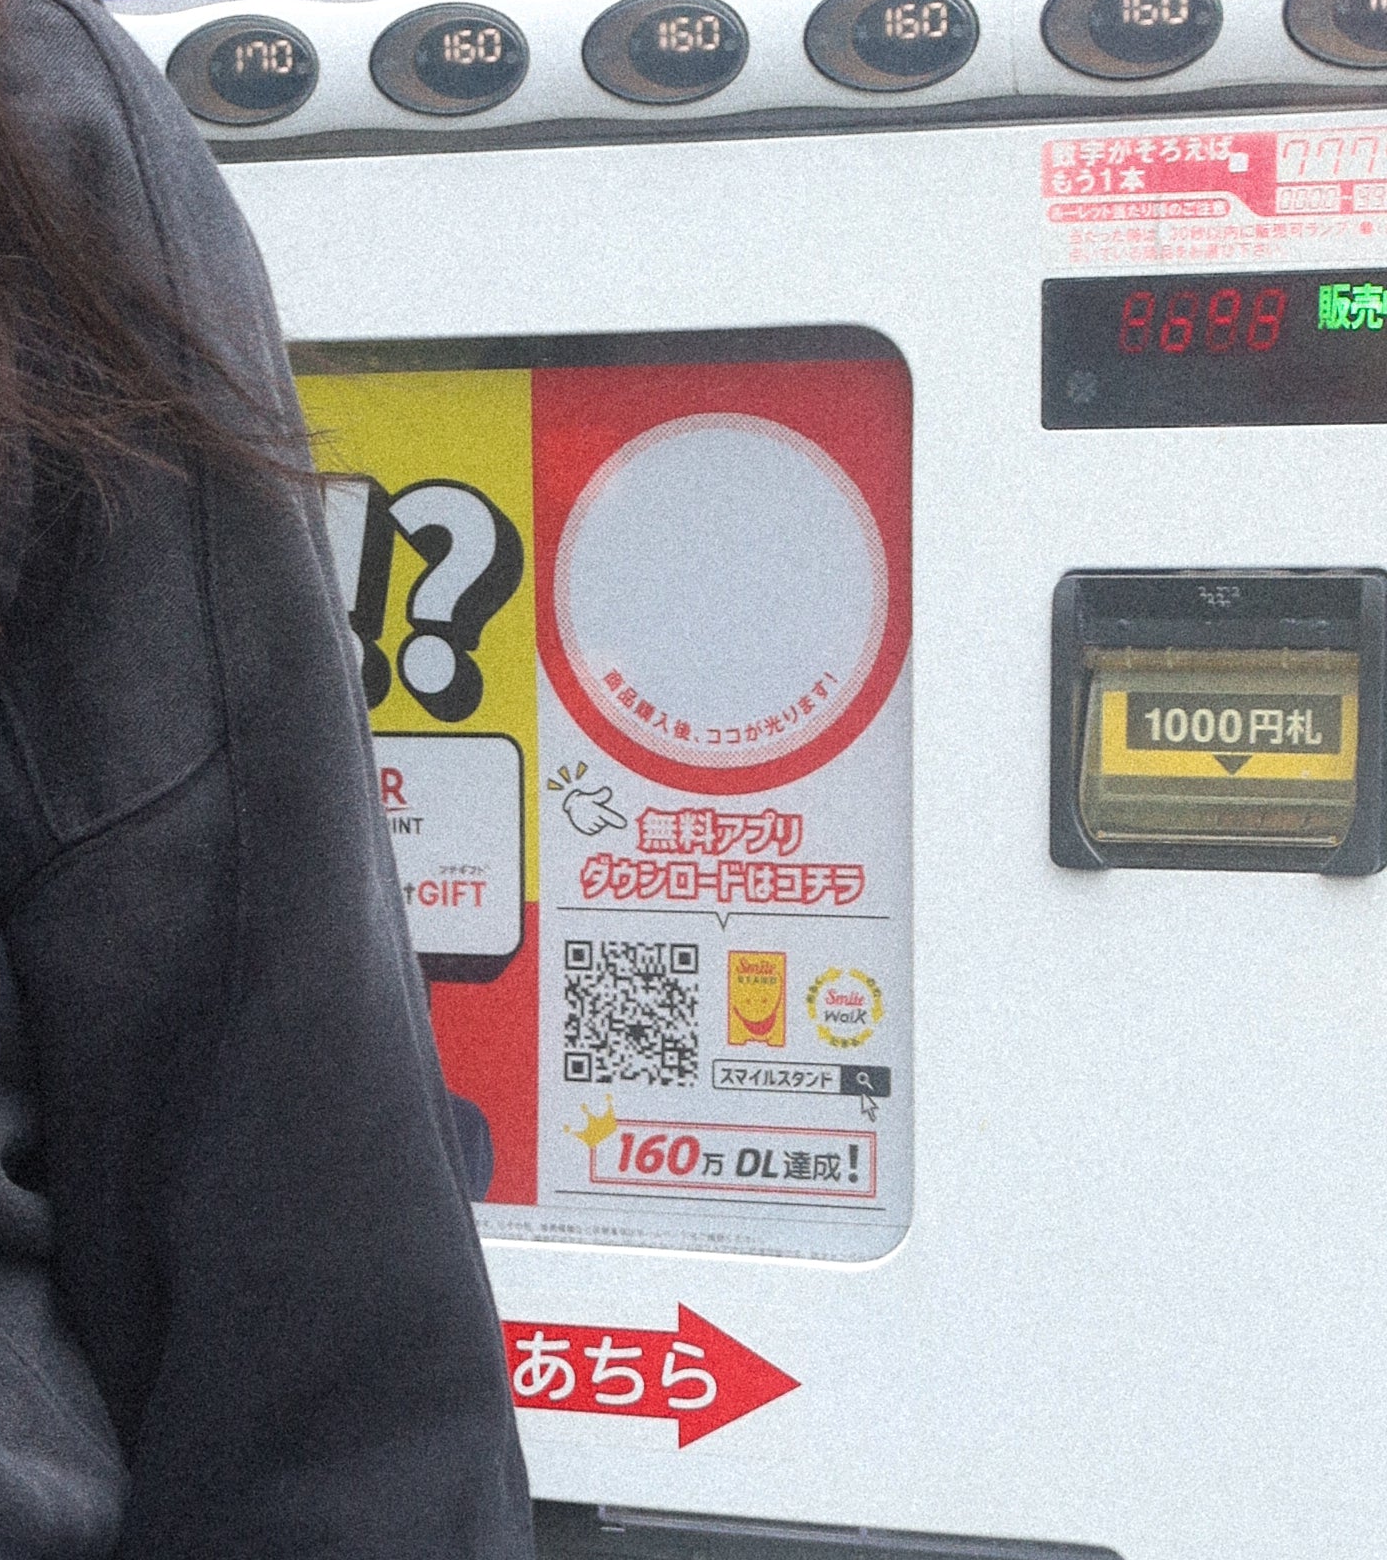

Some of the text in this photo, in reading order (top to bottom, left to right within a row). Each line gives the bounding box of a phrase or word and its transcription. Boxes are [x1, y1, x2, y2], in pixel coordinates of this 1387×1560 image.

[658, 16, 721, 52] 160
[885, 3, 949, 38] 160
[234, 40, 294, 75] 170
[443, 28, 503, 64] 160
[1051, 167, 1146, 195] もう1本
[1145, 705, 1323, 749] 1000円札
[636, 806, 803, 856] 無料アプリ
[579, 856, 867, 906] ダウンロードはコチラ
[826, 988, 866, 1007] Smile
[719, 1066, 833, 1090] スマイルスタンド
[512, 1330, 719, 1412] あちら
